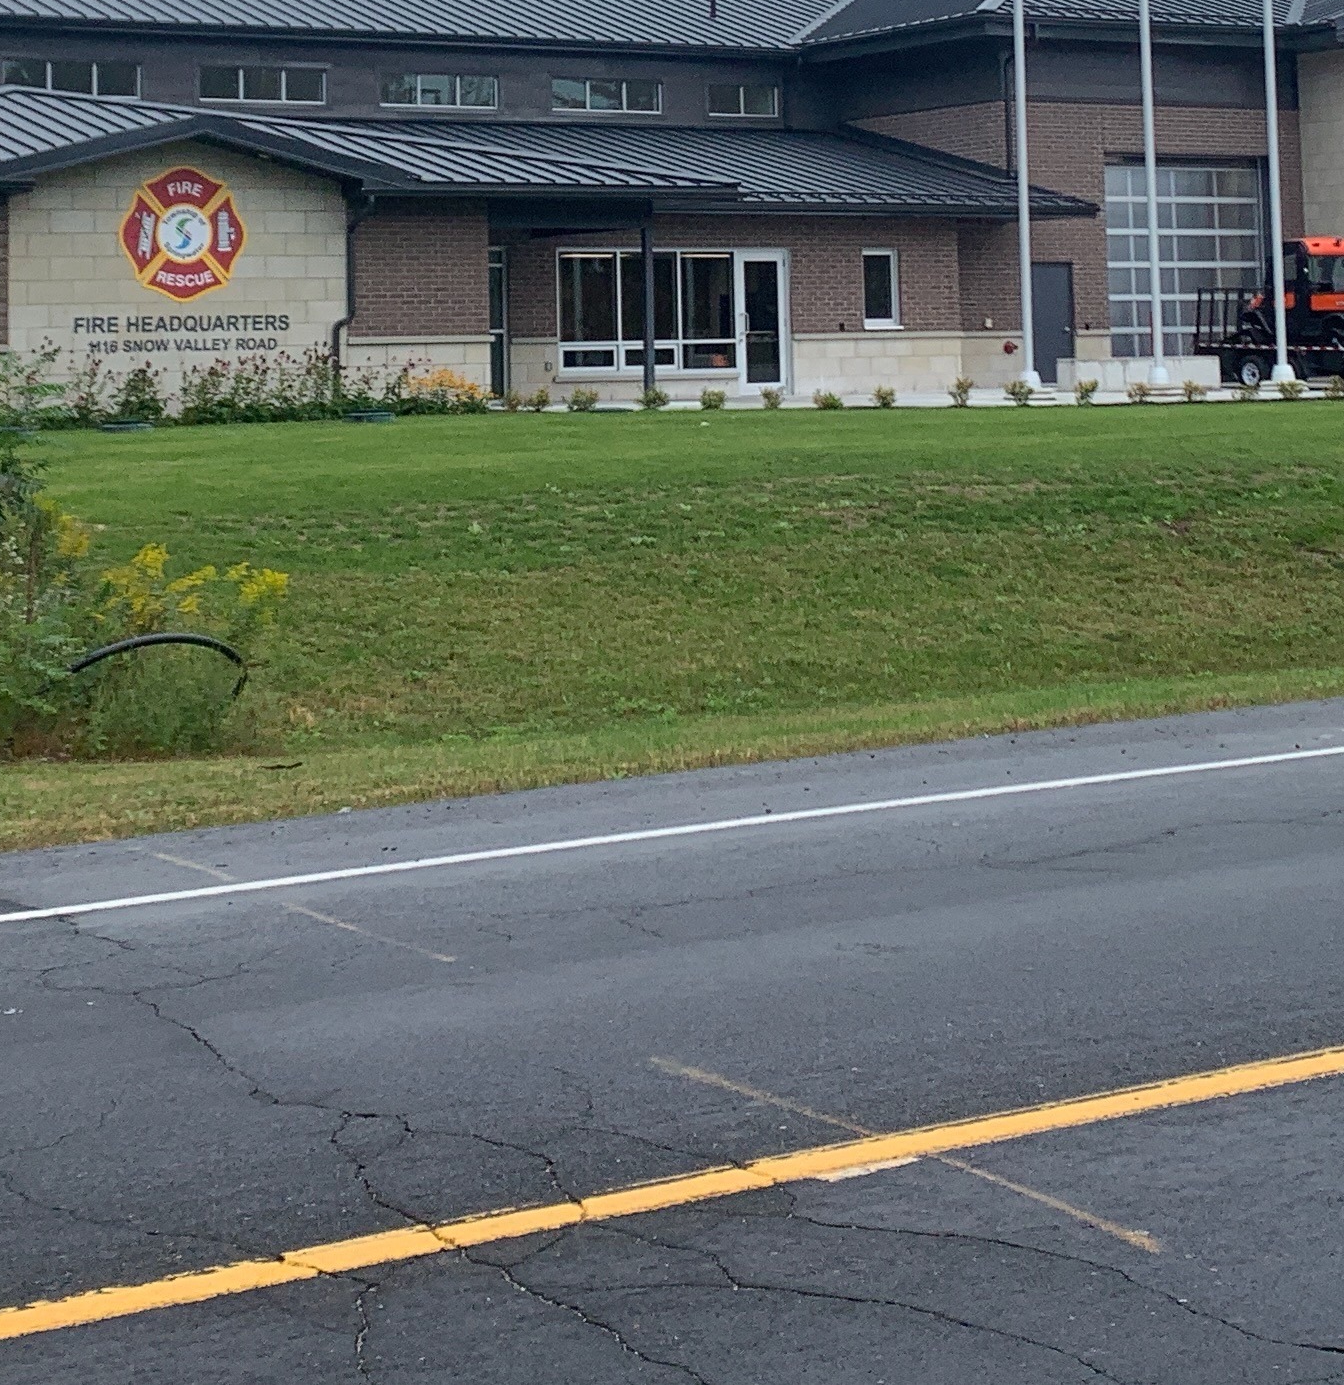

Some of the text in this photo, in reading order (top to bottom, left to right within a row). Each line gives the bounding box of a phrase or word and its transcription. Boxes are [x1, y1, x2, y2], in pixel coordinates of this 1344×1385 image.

[166, 181, 204, 197] FIRE
[156, 270, 215, 287] RESCUE
[73, 314, 290, 333] FIRE HEADQUARTERS
[123, 339, 170, 353] SNOW
[174, 338, 231, 352] VALLEY
[236, 337, 278, 351] ROAD
